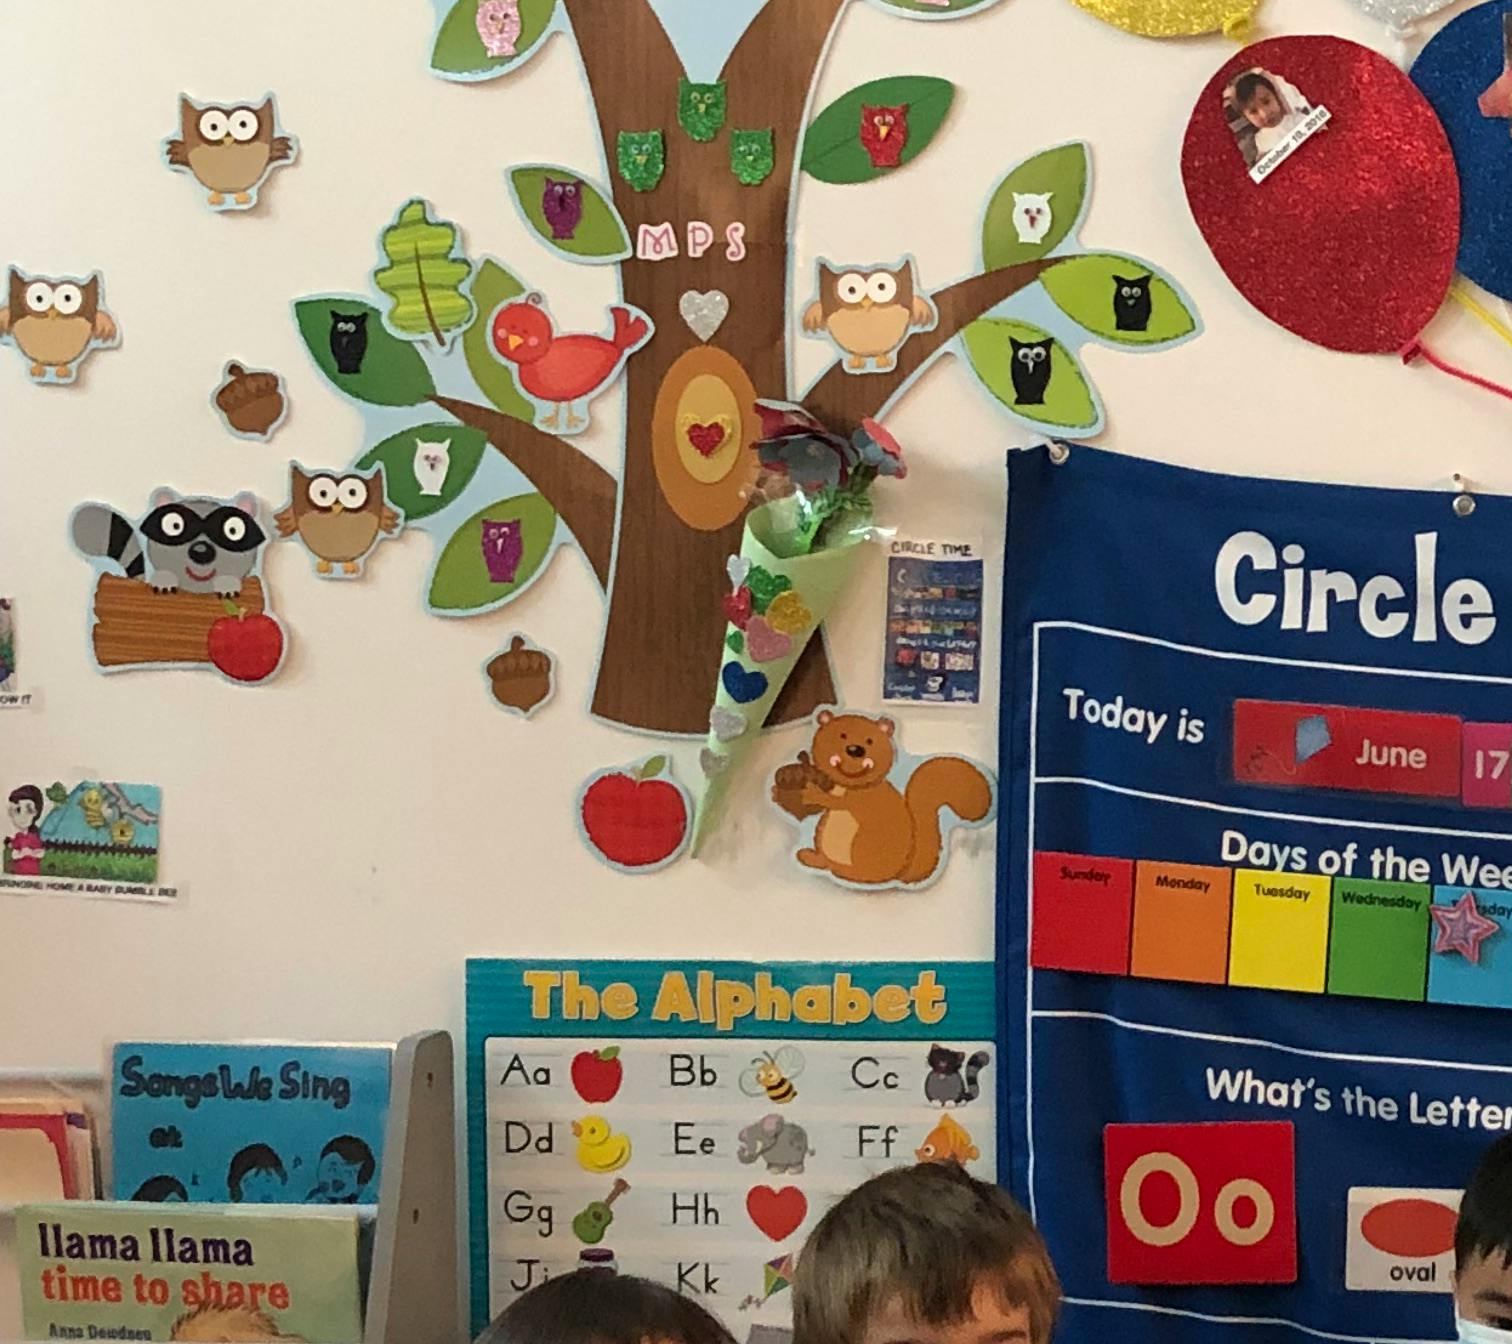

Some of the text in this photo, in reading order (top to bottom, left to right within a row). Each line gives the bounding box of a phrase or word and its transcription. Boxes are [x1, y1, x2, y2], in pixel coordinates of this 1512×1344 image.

[638, 222, 748, 262] MPS
[891, 541, 973, 557] CIRCLE TIME
[1214, 529, 1498, 646] Circle
[1062, 687, 1168, 744] Today
[1178, 707, 1205, 743] is
[1355, 738, 1428, 770] June
[1220, 829, 1308, 874] Days
[1317, 839, 1357, 877] of
[1369, 845, 1431, 883] the
[85, 883, 113, 895] BABY
[1059, 864, 1112, 886] Sunday
[1155, 873, 1212, 895] Monday
[1253, 882, 1311, 904] Tuesday
[1340, 890, 1422, 914] Wednesday
[522, 969, 949, 1031] The Alphabet
[120, 1054, 352, 1110] Songs We Sing
[500, 1053, 900, 1089] Aa Bb Cc
[1205, 1067, 1332, 1112] What's
[1341, 1086, 1399, 1120] the
[503, 1120, 900, 1158] Dd Ee Ff
[503, 1189, 720, 1238] Gg Hh
[1119, 1150, 1275, 1248] Oo
[37, 1222, 255, 1267] llama llama
[41, 1263, 292, 1311] time to share
[676, 1261, 720, 1295] Kk
[1389, 1261, 1437, 1284] oval
[48, 1321, 85, 1339] Anna
